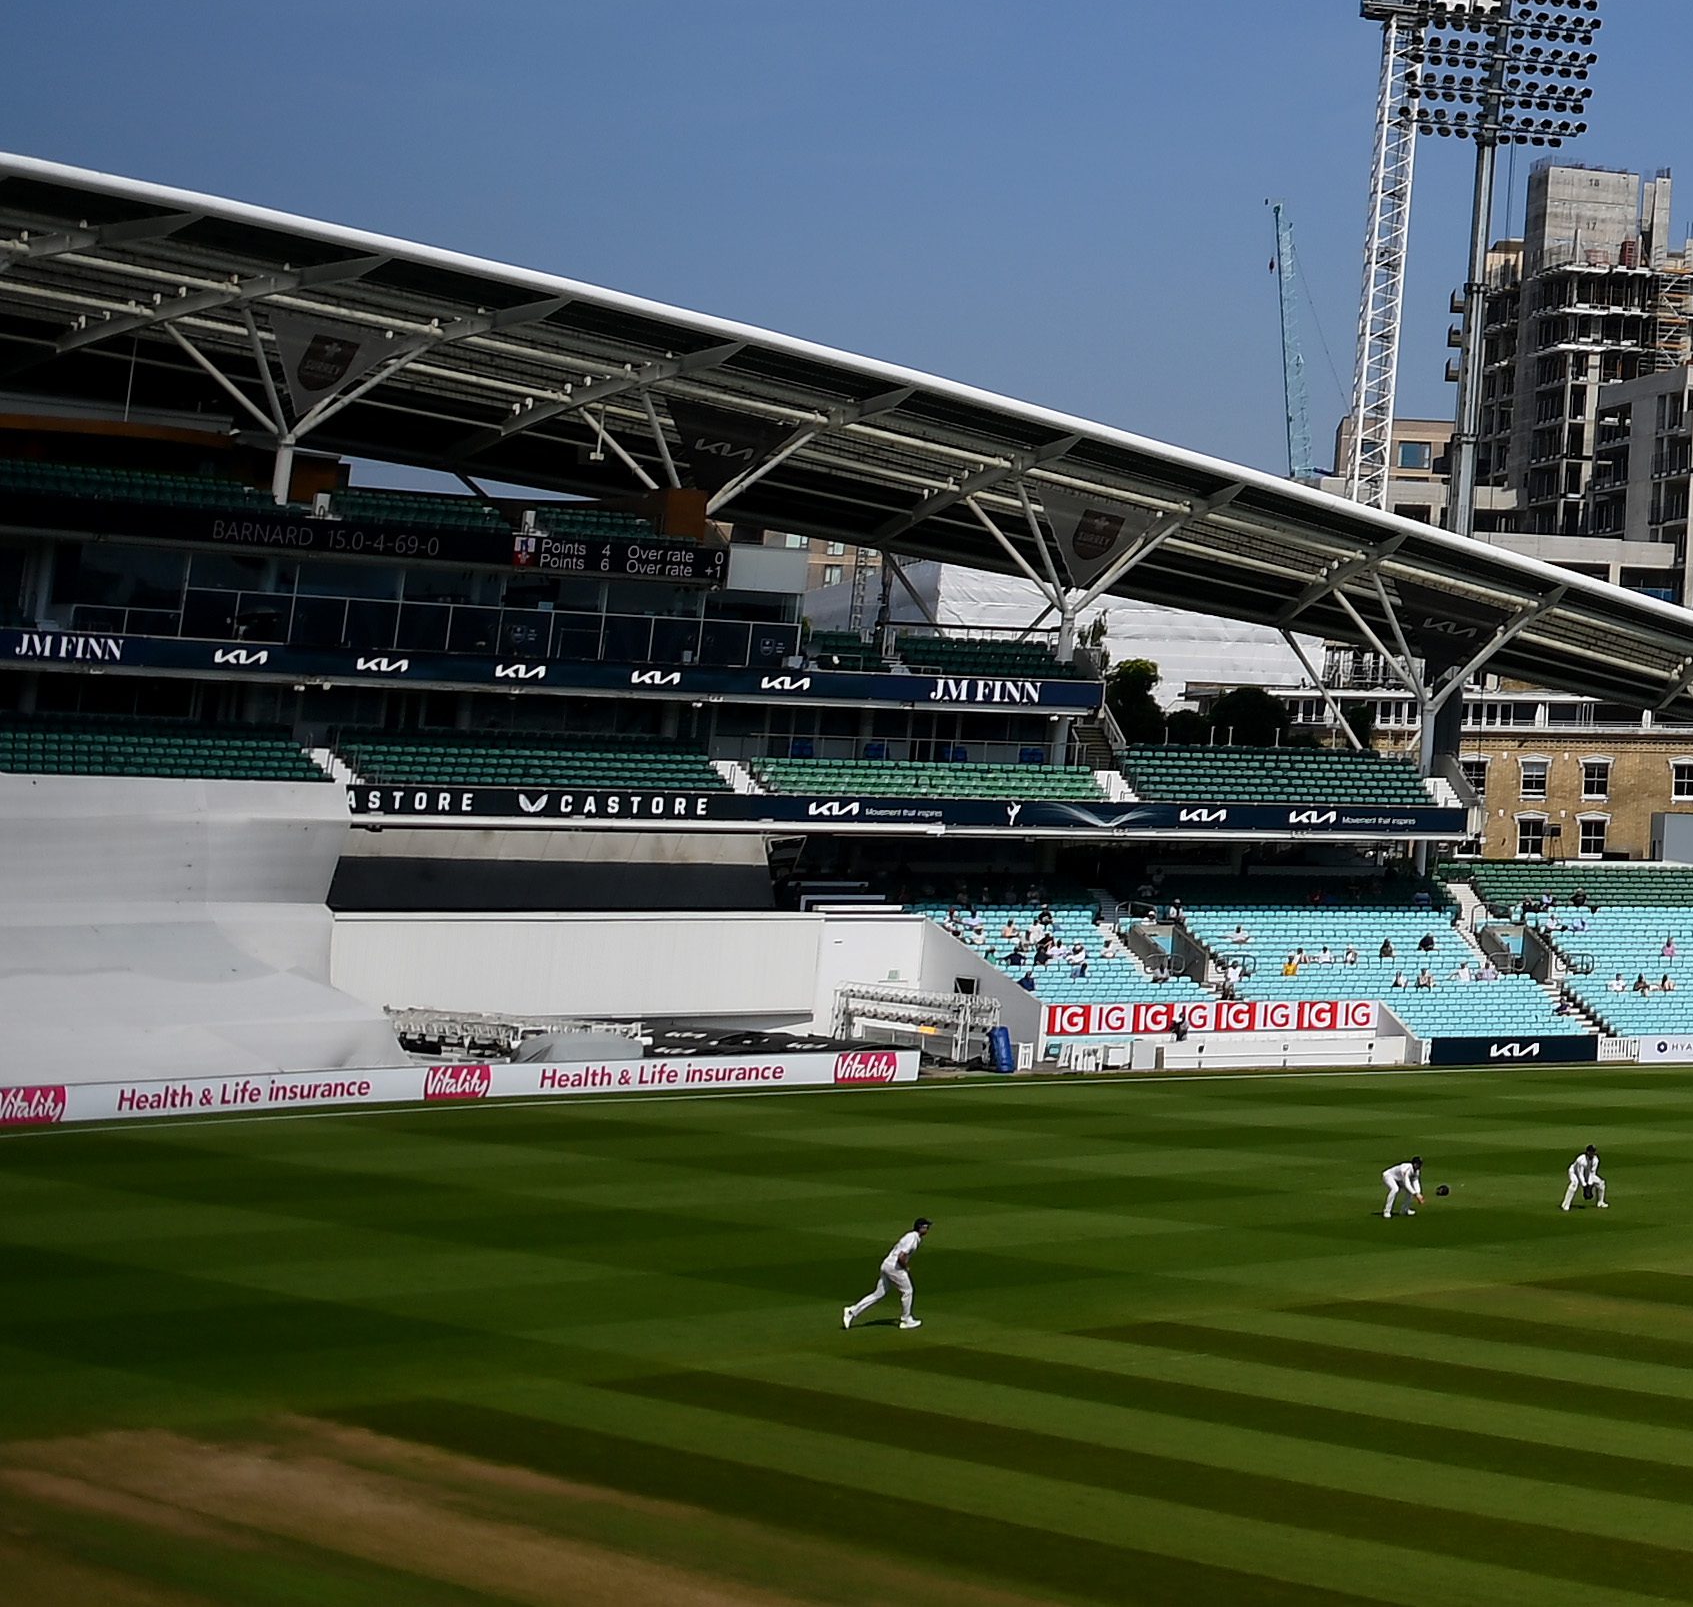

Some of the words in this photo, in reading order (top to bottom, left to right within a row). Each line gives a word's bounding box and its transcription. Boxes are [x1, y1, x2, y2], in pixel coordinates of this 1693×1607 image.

[212, 520, 313, 546] BARNARD
[327, 530, 440, 556] 15.0-4-69-0
[541, 539, 586, 555] Points
[602, 544, 611, 556] 4
[627, 546, 662, 560] Over
[667, 550, 694, 563] rate
[715, 552, 724, 564] 0
[540, 554, 584, 570] Points
[601, 558, 609, 570] 6
[626, 560, 661, 574] Over
[665, 563, 693, 577] rate
[705, 566, 722, 578] +1
[15, 633, 52, 657] JM
[58, 636, 124, 661] FINN
[930, 678, 970, 701] JM
[974, 680, 1041, 704] FINN
[560, 795, 709, 815] CASTORE
[1054, 1005, 1085, 1033] IG
[1097, 1005, 1126, 1031] IG
[1137, 1004, 1168, 1031] IG
[1220, 1003, 1251, 1029] IG
[1262, 1003, 1290, 1028] IG
[1302, 1002, 1332, 1028] IG
[1344, 1002, 1371, 1027] IG
[539, 1067, 612, 1090] Health
[618, 1068, 631, 1086] &
[638, 1063, 678, 1085] Life
[685, 1062, 784, 1084] insurance
[834, 1053, 898, 1083] Vitality
[117, 1085, 193, 1112] Health
[199, 1086, 213, 1107] &
[220, 1080, 262, 1105] Life
[268, 1078, 371, 1102] insurance
[425, 1066, 490, 1099] Vitality
